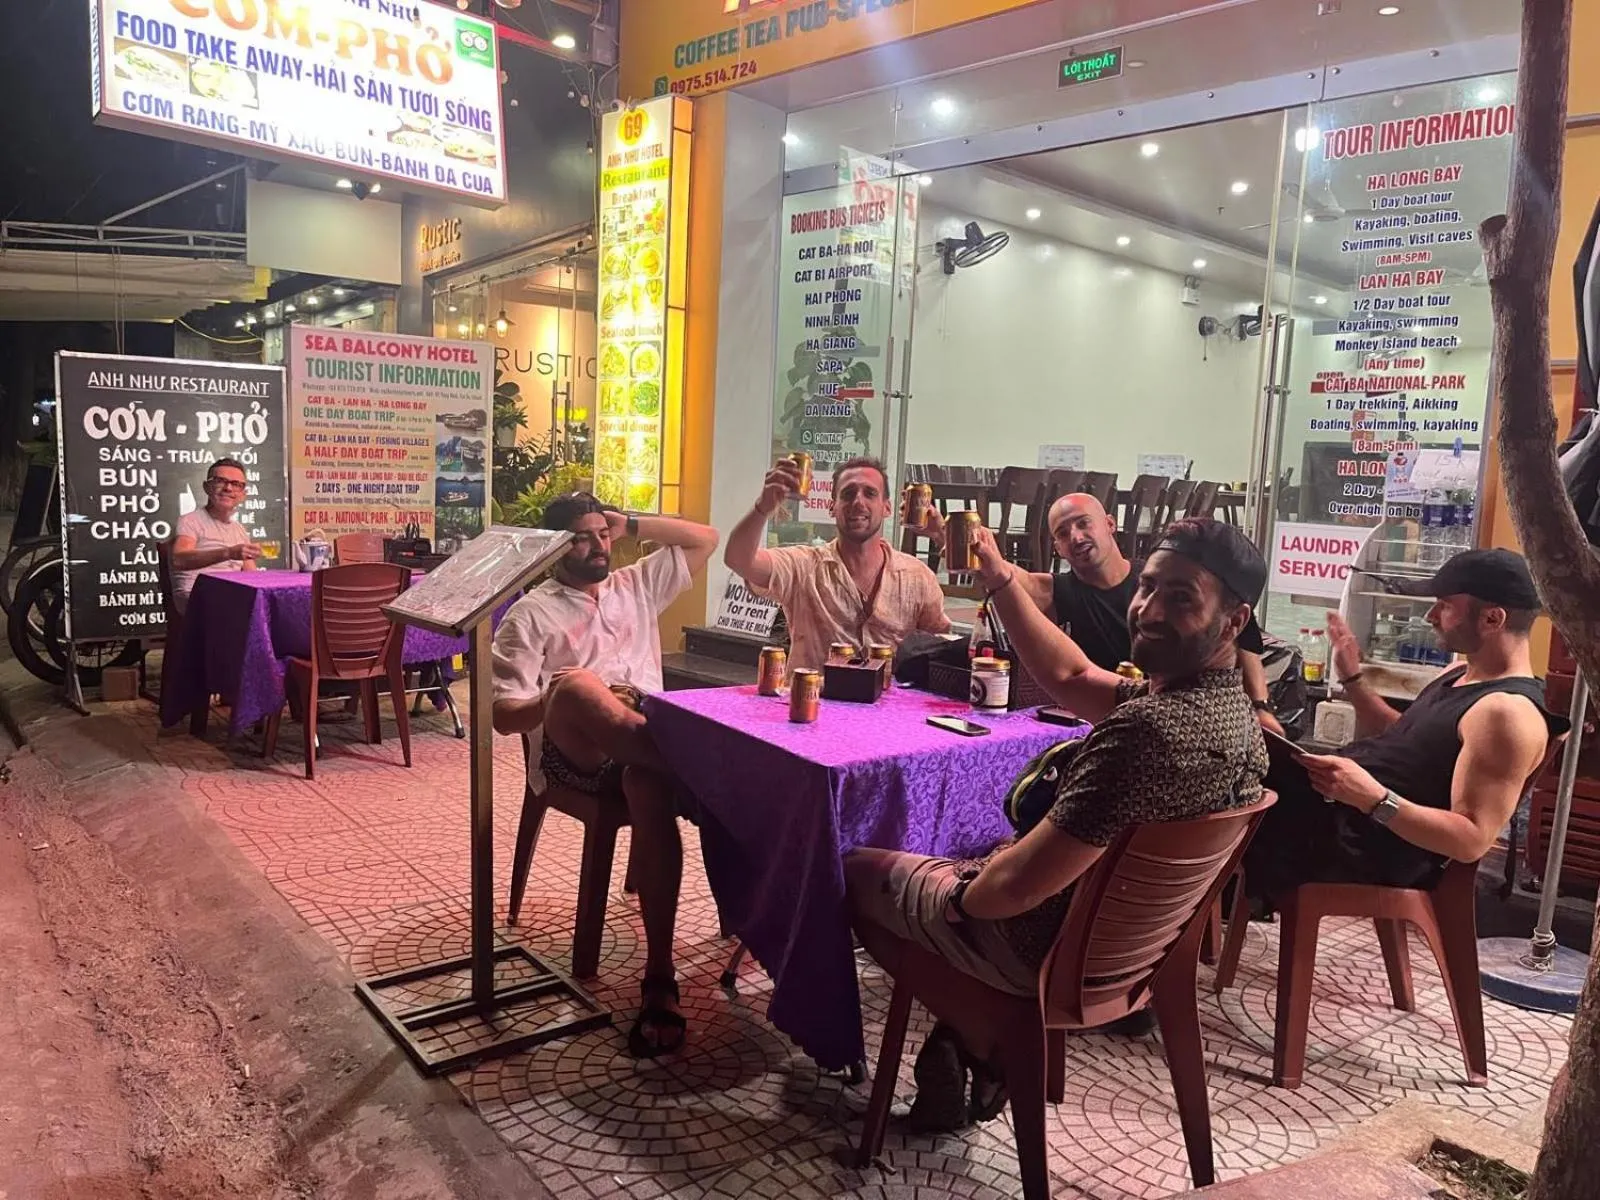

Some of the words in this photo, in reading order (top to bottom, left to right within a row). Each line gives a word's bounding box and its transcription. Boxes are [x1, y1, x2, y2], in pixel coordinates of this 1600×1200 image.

[116, 10, 177, 49] FOOD
[184, 28, 238, 65] TAKE
[674, 28, 738, 69] COFFEE
[747, 16, 782, 48] TEA
[1076, 69, 1102, 81] EXIT
[624, 112, 642, 141] 69
[122, 90, 174, 120] CƠM
[462, 171, 494, 194] CUA
[1323, 124, 1373, 160] TOUR
[603, 164, 667, 188] Restaurant
[1367, 175, 1387, 190] HA
[1391, 170, 1429, 189] LONG
[1433, 165, 1463, 183] BAY
[612, 186, 657, 206] Breakfast
[1372, 199, 1378, 210] 1
[1380, 196, 1400, 210] Day
[1403, 193, 1427, 206] boat
[1430, 191, 1453, 204] tour
[791, 210, 827, 234] BOOKING
[830, 205, 847, 228] BUS
[849, 200, 886, 226] TICKETS
[1355, 216, 1410, 232] Kayaking,
[1409, 233, 1435, 246] Visit
[1438, 229, 1473, 243] caves
[799, 247, 816, 260] CAT
[854, 240, 874, 254] NOI
[795, 269, 812, 283] CAT
[815, 268, 825, 281] BI
[828, 263, 874, 280] AIRPORT
[1359, 274, 1389, 290] LAN
[1392, 272, 1411, 288] HA
[1416, 269, 1445, 286] BAY
[805, 292, 822, 305] HAI
[825, 288, 862, 303] PHONG
[1353, 299, 1370, 311] 1/2
[1373, 297, 1395, 311] Day
[1399, 295, 1424, 308] boat
[1427, 295, 1451, 306] tour
[805, 315, 831, 328] NINH
[833, 313, 860, 326] BINH
[1338, 319, 1393, 333] Kayaking,
[1396, 316, 1459, 328] swimming
[600, 324, 636, 340] Seafood
[305, 334, 337, 352] SEA
[343, 338, 423, 359] BALCONY
[427, 345, 478, 364] HOTEL
[806, 338, 820, 351] HA
[823, 336, 856, 350] GIANG
[1335, 338, 1379, 353] Monkey
[1421, 335, 1457, 348] beach
[495, 347, 597, 380] RUSTIC
[816, 360, 843, 373] SAPA
[1364, 357, 1390, 371] (Any
[1394, 355, 1425, 369] time)
[305, 357, 374, 382] TOURIST
[379, 363, 480, 390] INFORMATION
[88, 371, 124, 388] ANH
[129, 375, 167, 390] NHƯ
[170, 377, 270, 396] RESTAURANT
[818, 383, 838, 396] HUE
[1325, 377, 1345, 391] CAT
[1350, 377, 1366, 391] BA
[1368, 375, 1427, 390] NATIONAL
[1430, 375, 1466, 389] PARK
[307, 395, 322, 405] CAT
[343, 398, 359, 407] LAN
[378, 399, 389, 408] HA
[391, 400, 411, 410] LONG
[413, 401, 427, 410] BAY
[805, 404, 820, 417] DA
[822, 403, 851, 416] NANG
[1336, 399, 1356, 412] Day
[1359, 399, 1409, 412] trekking,
[1412, 398, 1458, 411] Aikking
[303, 406, 324, 418] ONE
[326, 408, 345, 419] DAY
[348, 409, 371, 421] BOAT
[375, 410, 395, 422] TRIP
[83, 401, 168, 442] CƠM
[196, 401, 269, 445] PHỞ
[599, 419, 628, 434] Special
[629, 419, 658, 433] dinner
[1310, 419, 1353, 432] Boating,
[1357, 419, 1420, 432] swimming,
[1423, 418, 1479, 432] kayaking
[305, 433, 316, 442] CAT
[319, 434, 327, 443] BA
[333, 435, 346, 444] LAN
[348, 435, 357, 444] HA
[358, 436, 370, 445] BAY
[376, 437, 400, 446] FISHING
[402, 438, 429, 447] VILLAGES
[815, 432, 845, 445] CONTACT
[99, 445, 151, 463] SÁNG
[169, 450, 215, 465] TRƯA
[304, 446, 311, 457] A
[314, 446, 338, 458] HALF
[341, 447, 360, 459] DAY
[361, 448, 384, 460] BOAT
[387, 449, 407, 460] TRIP
[100, 464, 157, 487] BÚN
[1338, 461, 1357, 476] HA
[315, 483, 320, 493] 2
[322, 483, 341, 493] DAYS
[347, 484, 362, 493] ONE
[363, 484, 384, 494] NIGHT
[386, 484, 403, 494] BOAT
[405, 484, 420, 494] TRIP
[1343, 485, 1351, 495] 2
[1354, 485, 1377, 498] Day
[101, 489, 160, 514] PHỞ
[1329, 502, 1353, 515] Over
[1388, 507, 1402, 517] on
[304, 511, 317, 524] CAT
[319, 511, 329, 524] BA
[335, 511, 369, 524] NATIONAL
[371, 511, 389, 525] PARK
[91, 516, 171, 540] CHÁO
[100, 569, 136, 584] BÁNH
[139, 571, 159, 584] ĐA
[1279, 559, 1351, 581] SERVIC
[99, 592, 136, 607] BÁNH
[727, 601, 743, 615] for
[745, 607, 769, 620] rent
